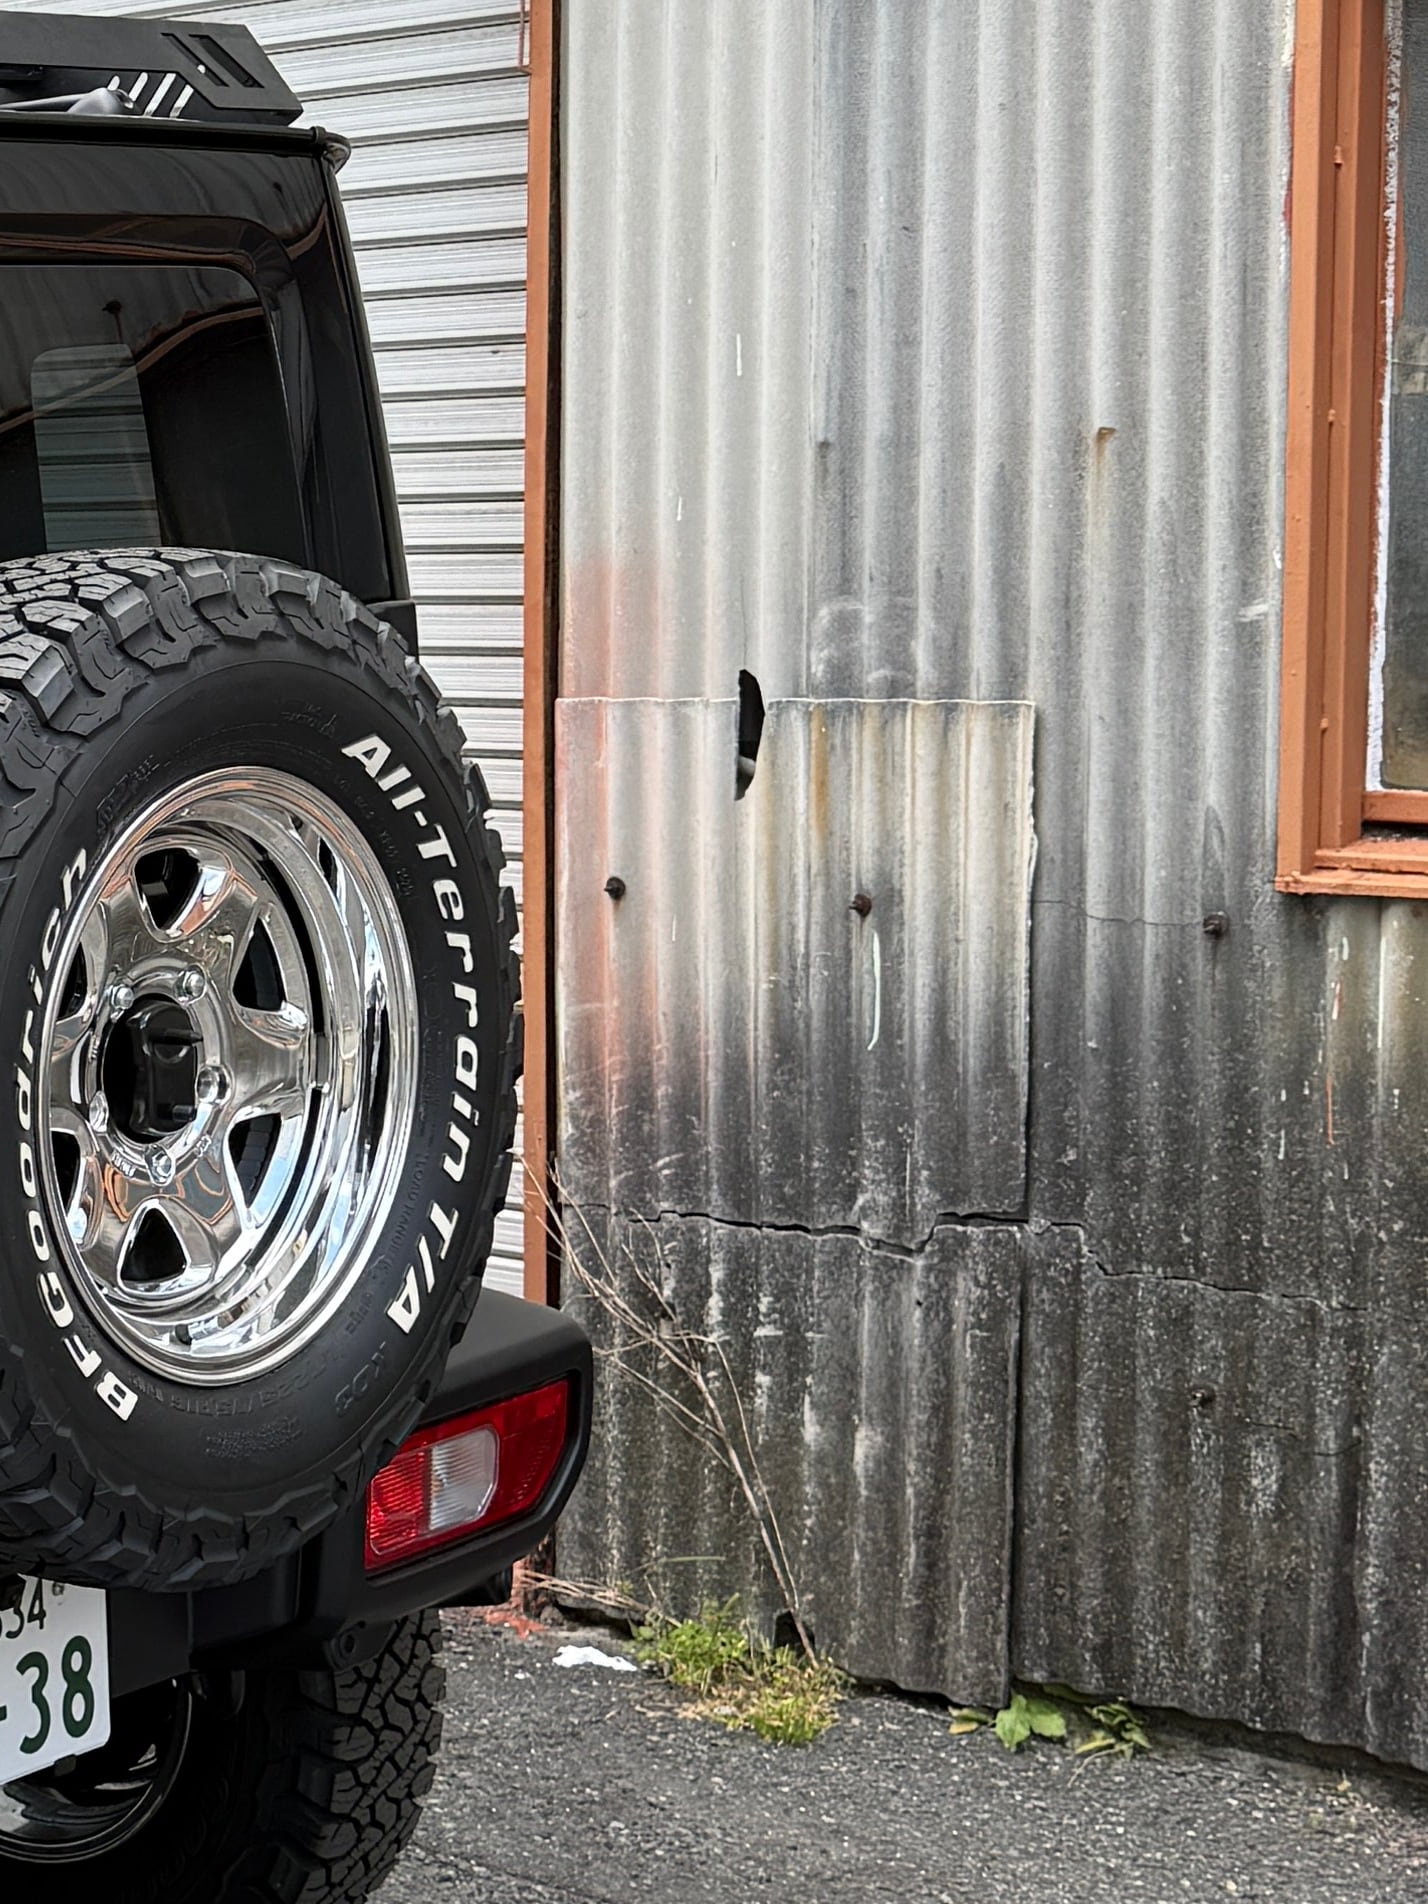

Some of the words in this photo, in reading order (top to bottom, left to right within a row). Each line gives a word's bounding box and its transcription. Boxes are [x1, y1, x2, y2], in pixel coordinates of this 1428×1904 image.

[15, 848, 138, 1421] BFGoodrich
[341, 733, 480, 1182] All-Terrain
[386, 1201, 459, 1334] T/A
